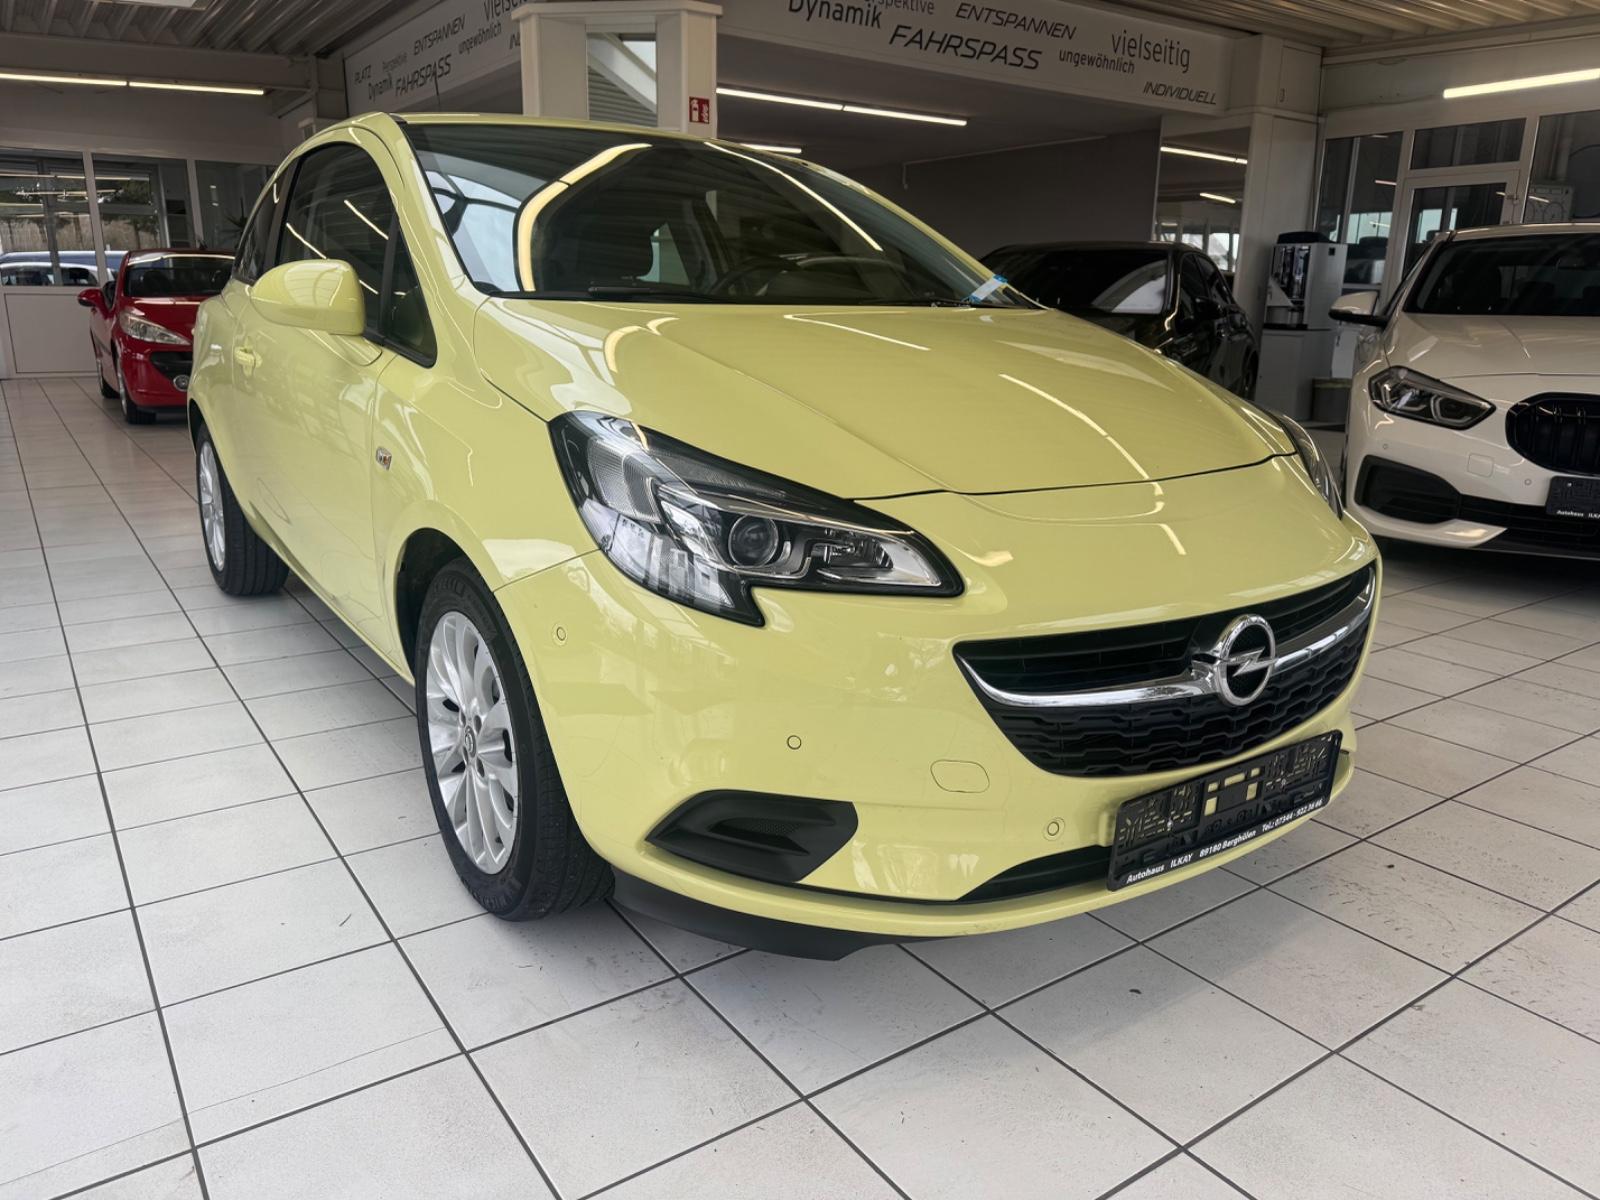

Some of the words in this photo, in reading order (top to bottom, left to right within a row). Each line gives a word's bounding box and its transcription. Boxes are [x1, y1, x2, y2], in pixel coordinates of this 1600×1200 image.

[788, 0, 882, 28] Dynamik
[956, 2, 1077, 40] ENTSPANNEN
[414, 14, 465, 55] ENTSPANNEN
[458, 21, 502, 54] ungewöhnlich
[889, 24, 1042, 70] FAHRSPASS
[1111, 30, 1190, 73] vielseitig
[395, 54, 451, 96] FAHRSPASS
[1059, 48, 1135, 74] ungewöhnlich
[1143, 81, 1217, 105] INDIVIDUELL
[1126, 865, 1165, 883] Autohaus
[1170, 853, 1193, 868] ILKAY
[1199, 842, 1221, 858] 89180
[1222, 829, 1257, 849] Berghülen
